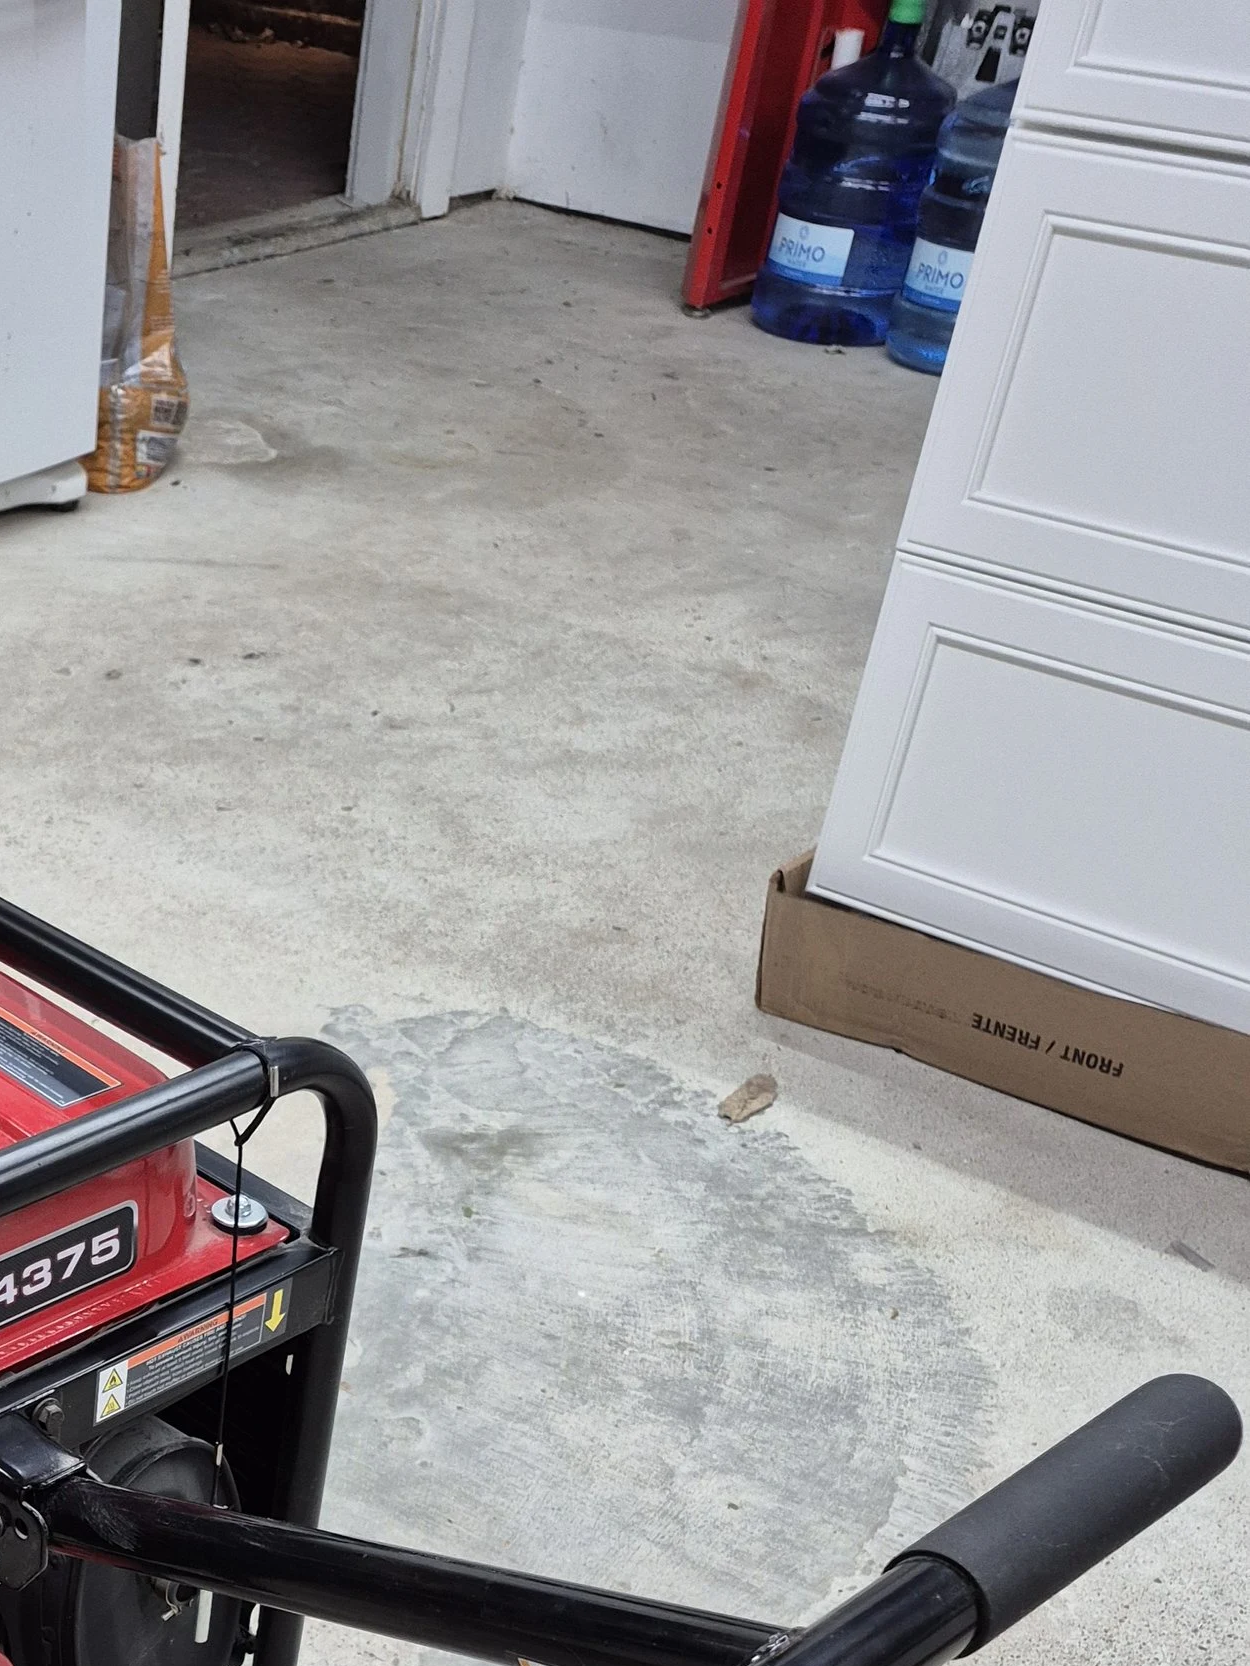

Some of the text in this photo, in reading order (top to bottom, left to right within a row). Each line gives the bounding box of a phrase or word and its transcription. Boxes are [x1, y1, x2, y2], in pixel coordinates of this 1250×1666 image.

[778, 236, 825, 263] PRIMO
[917, 263, 964, 289] PRIMO
[971, 1012, 1124, 1078] FRONT / FRENTE
